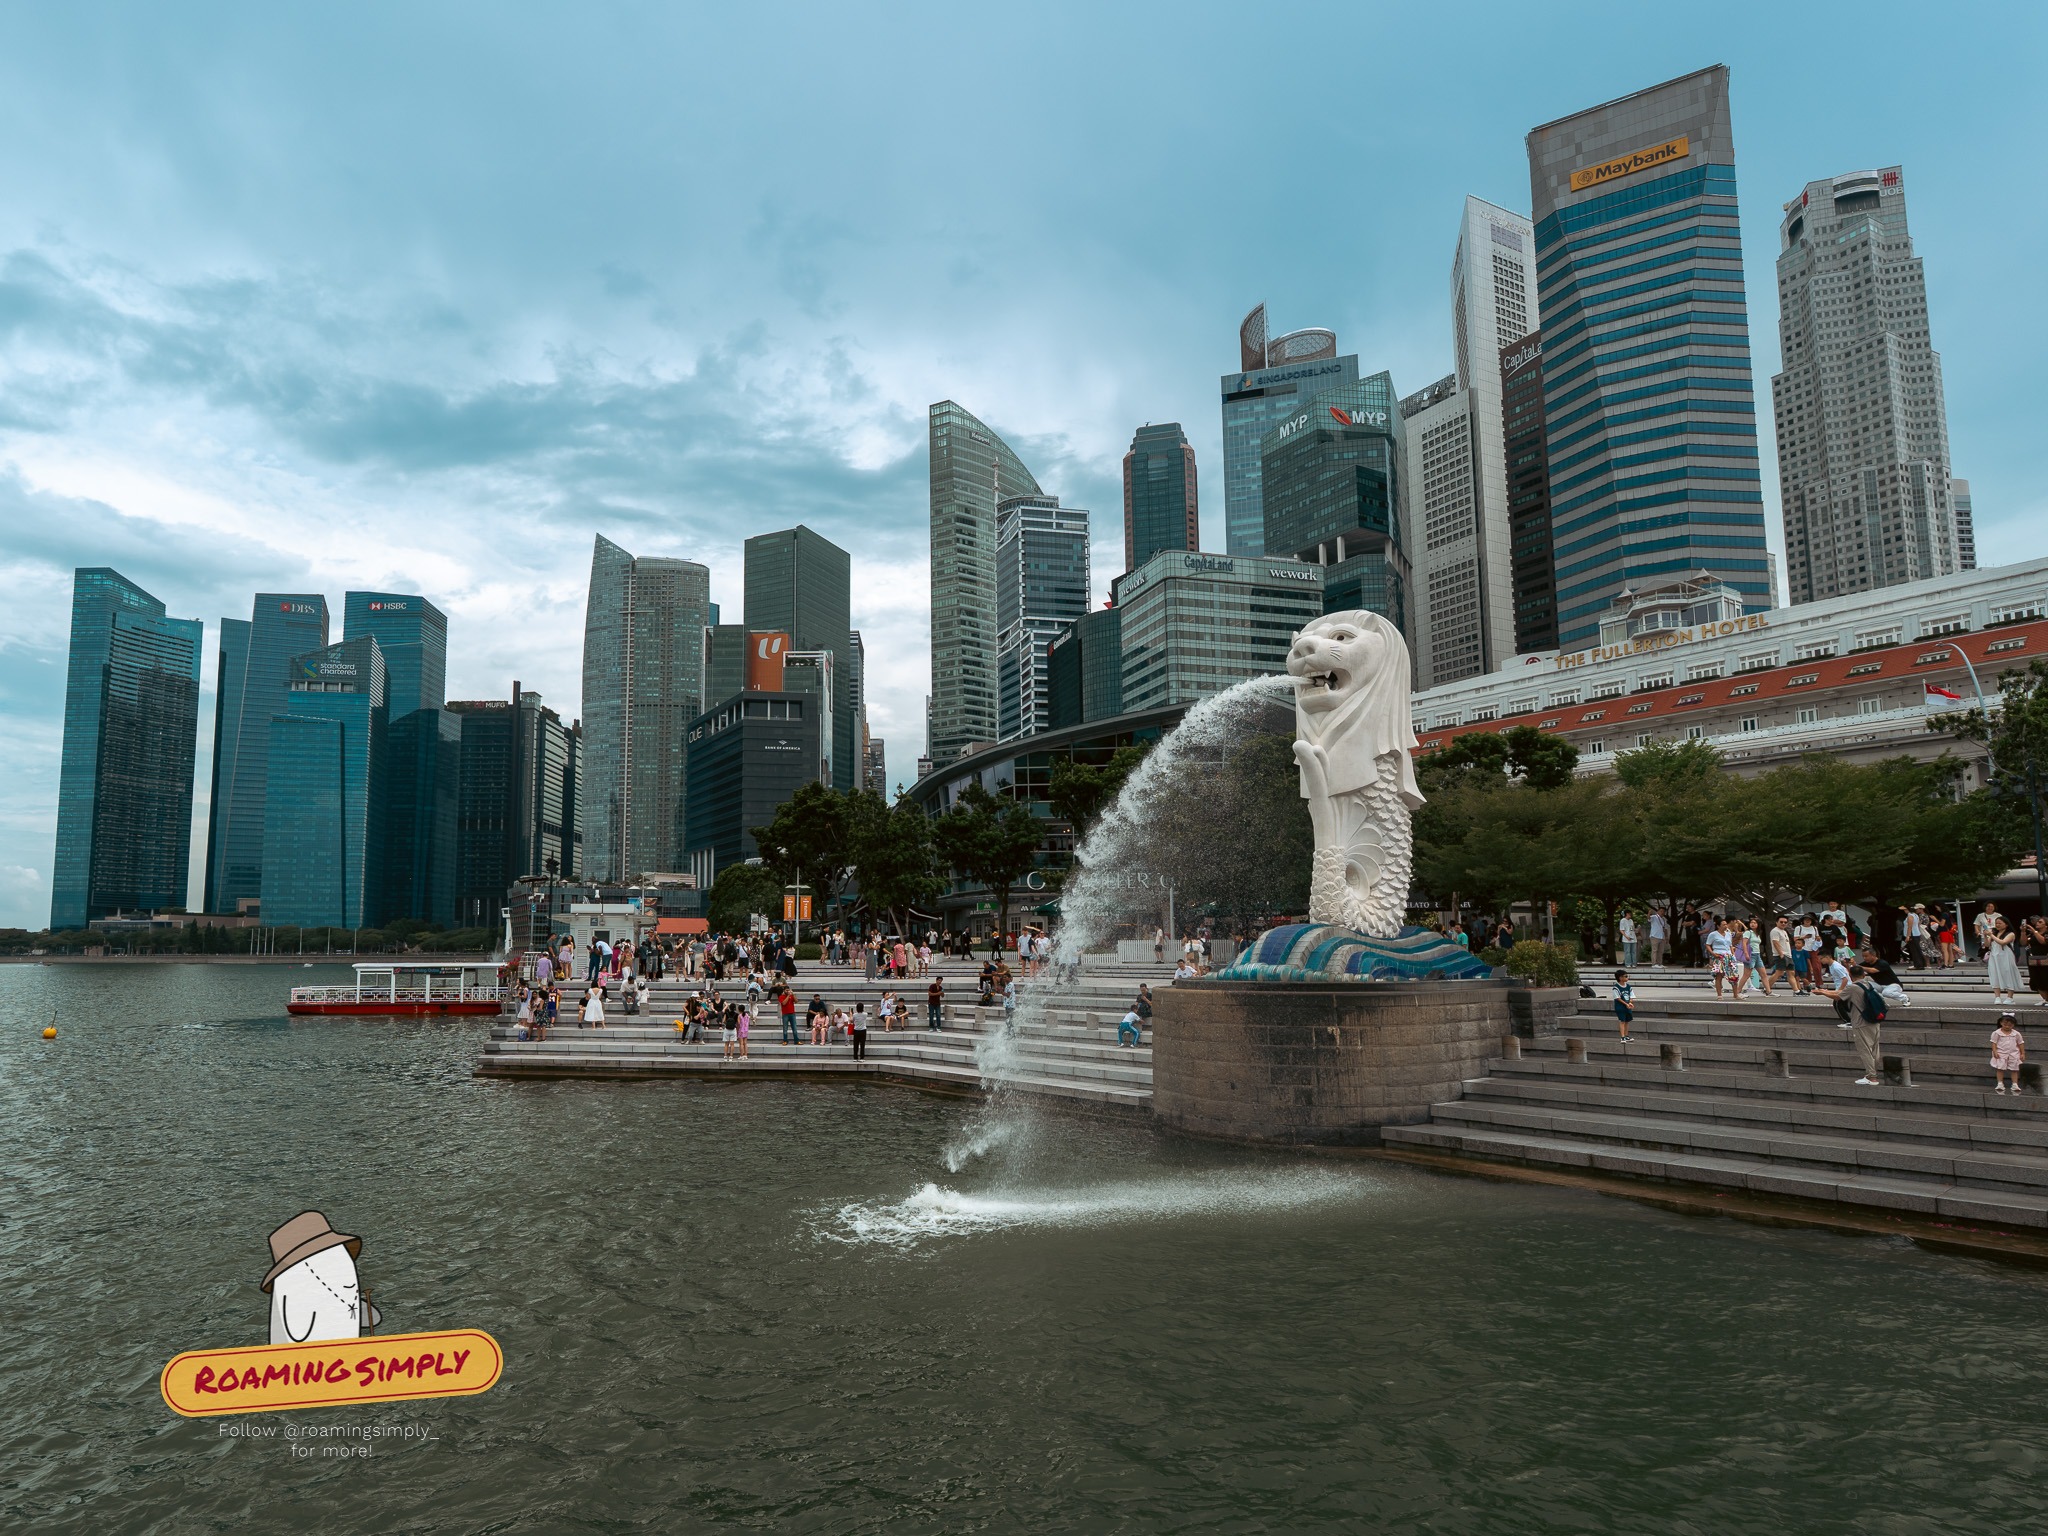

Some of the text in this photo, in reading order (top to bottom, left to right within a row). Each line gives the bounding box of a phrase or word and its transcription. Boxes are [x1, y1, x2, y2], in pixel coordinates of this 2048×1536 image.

[1595, 144, 1677, 179] Maybank
[1880, 187, 1904, 197] UOB
[1257, 364, 1342, 385] SINGAPORELAND
[1352, 411, 1387, 425] MYP
[1279, 414, 1308, 440] MYP
[1184, 554, 1234, 572] CapitaLand
[1269, 568, 1317, 581] wework
[292, 603, 315, 614] DBS
[384, 602, 407, 610] HSBC
[1554, 613, 1769, 669] THE FULLERTON HOTEL
[320, 662, 355, 670] standard
